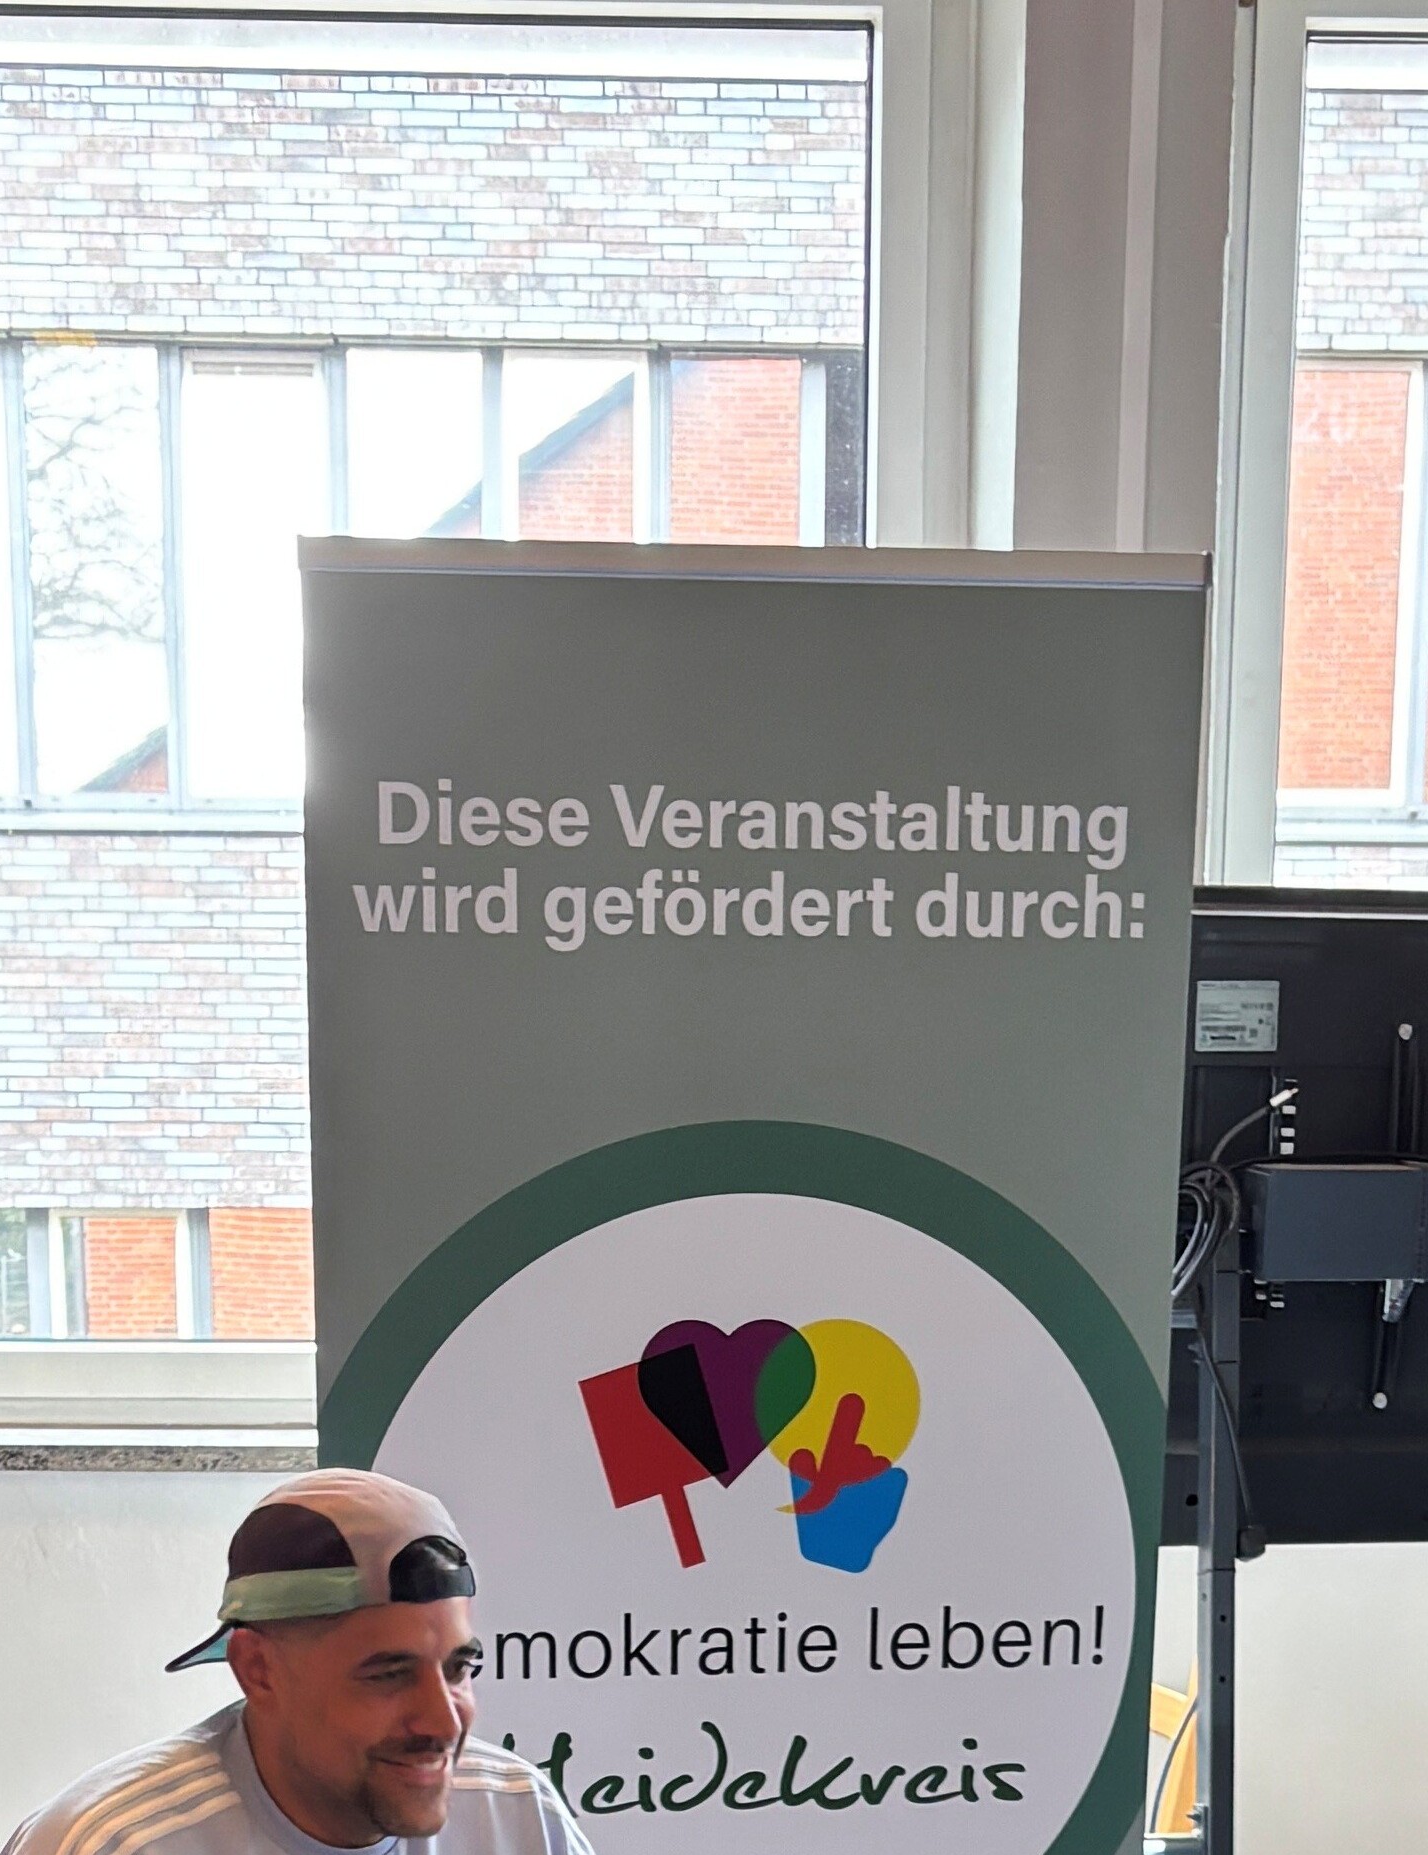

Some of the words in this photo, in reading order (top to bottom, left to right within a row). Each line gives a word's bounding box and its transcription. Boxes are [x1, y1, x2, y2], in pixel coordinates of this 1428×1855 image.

[378, 778, 590, 847] Diese
[609, 784, 1128, 871] Veranstaltung
[352, 866, 519, 934] wird
[544, 868, 895, 952] gefördert
[915, 872, 1145, 939] durch:
[469, 1611, 838, 1680] mokratie
[869, 1604, 1104, 1671] leben!
